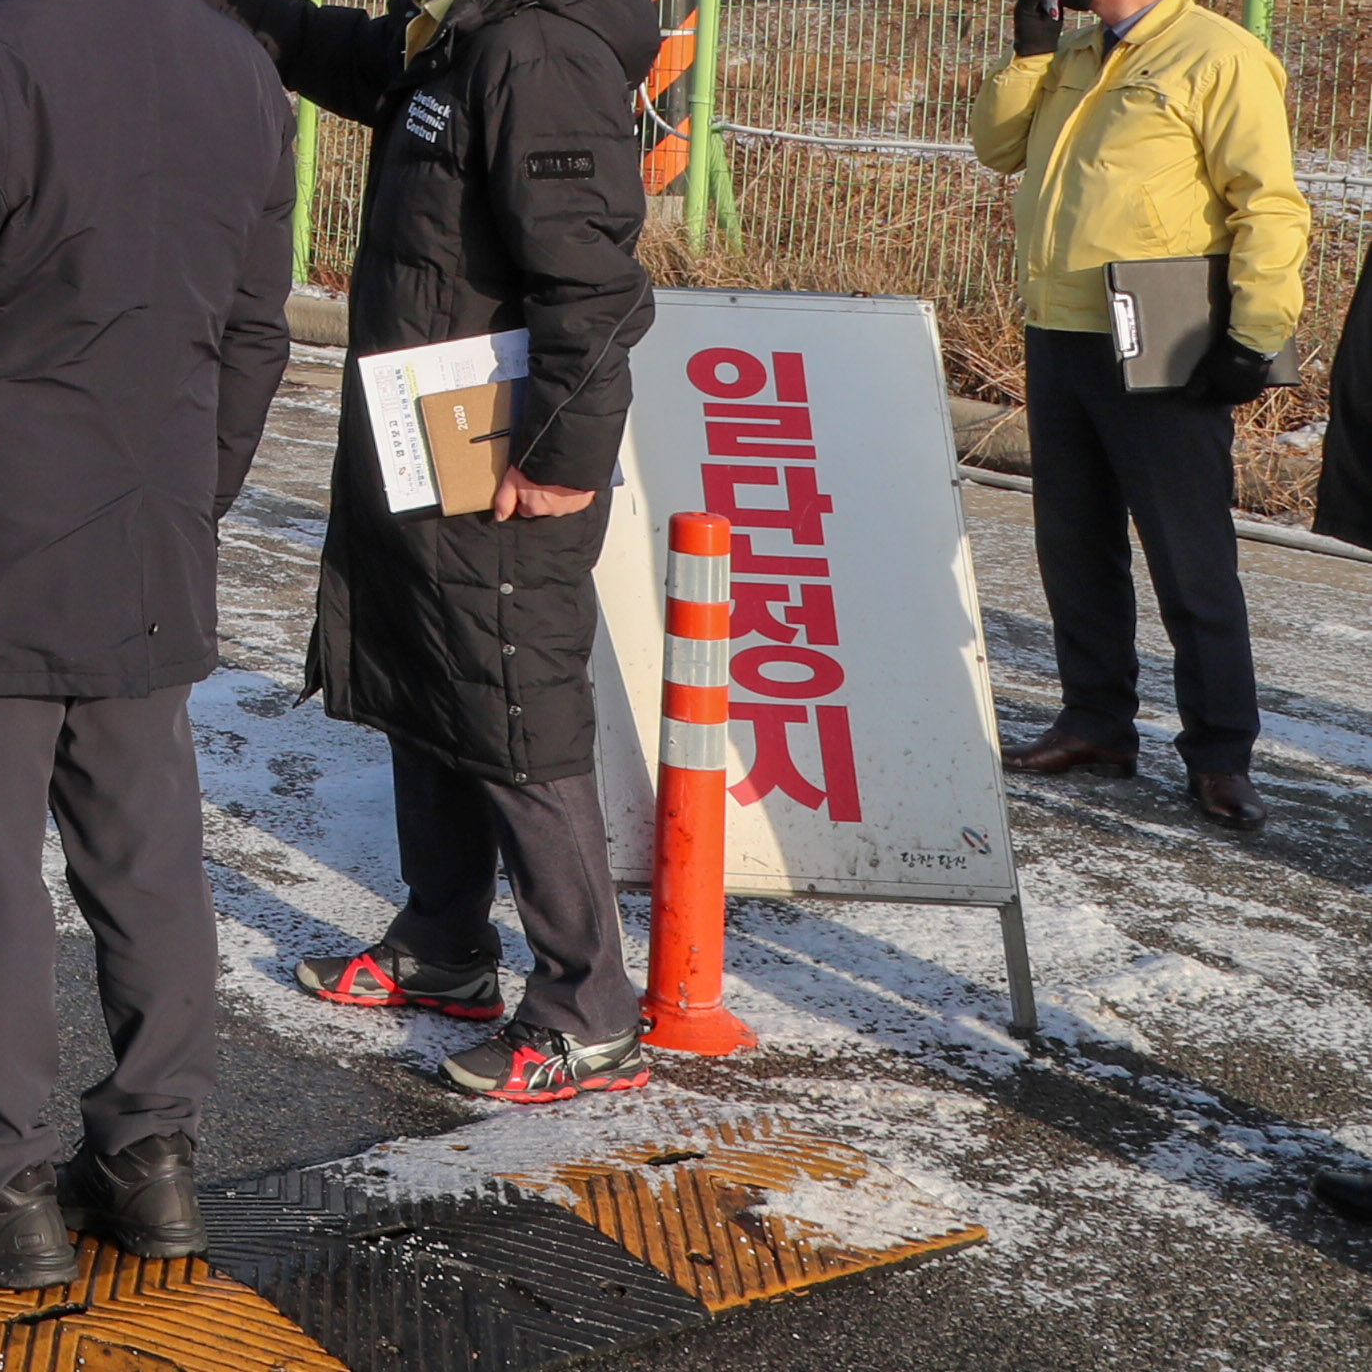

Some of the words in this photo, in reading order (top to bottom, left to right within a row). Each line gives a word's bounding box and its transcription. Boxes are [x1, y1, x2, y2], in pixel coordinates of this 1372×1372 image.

[408, 102, 446, 131] Epidemic
[407, 118, 437, 143] Control
[453, 404, 469, 431] 2020
